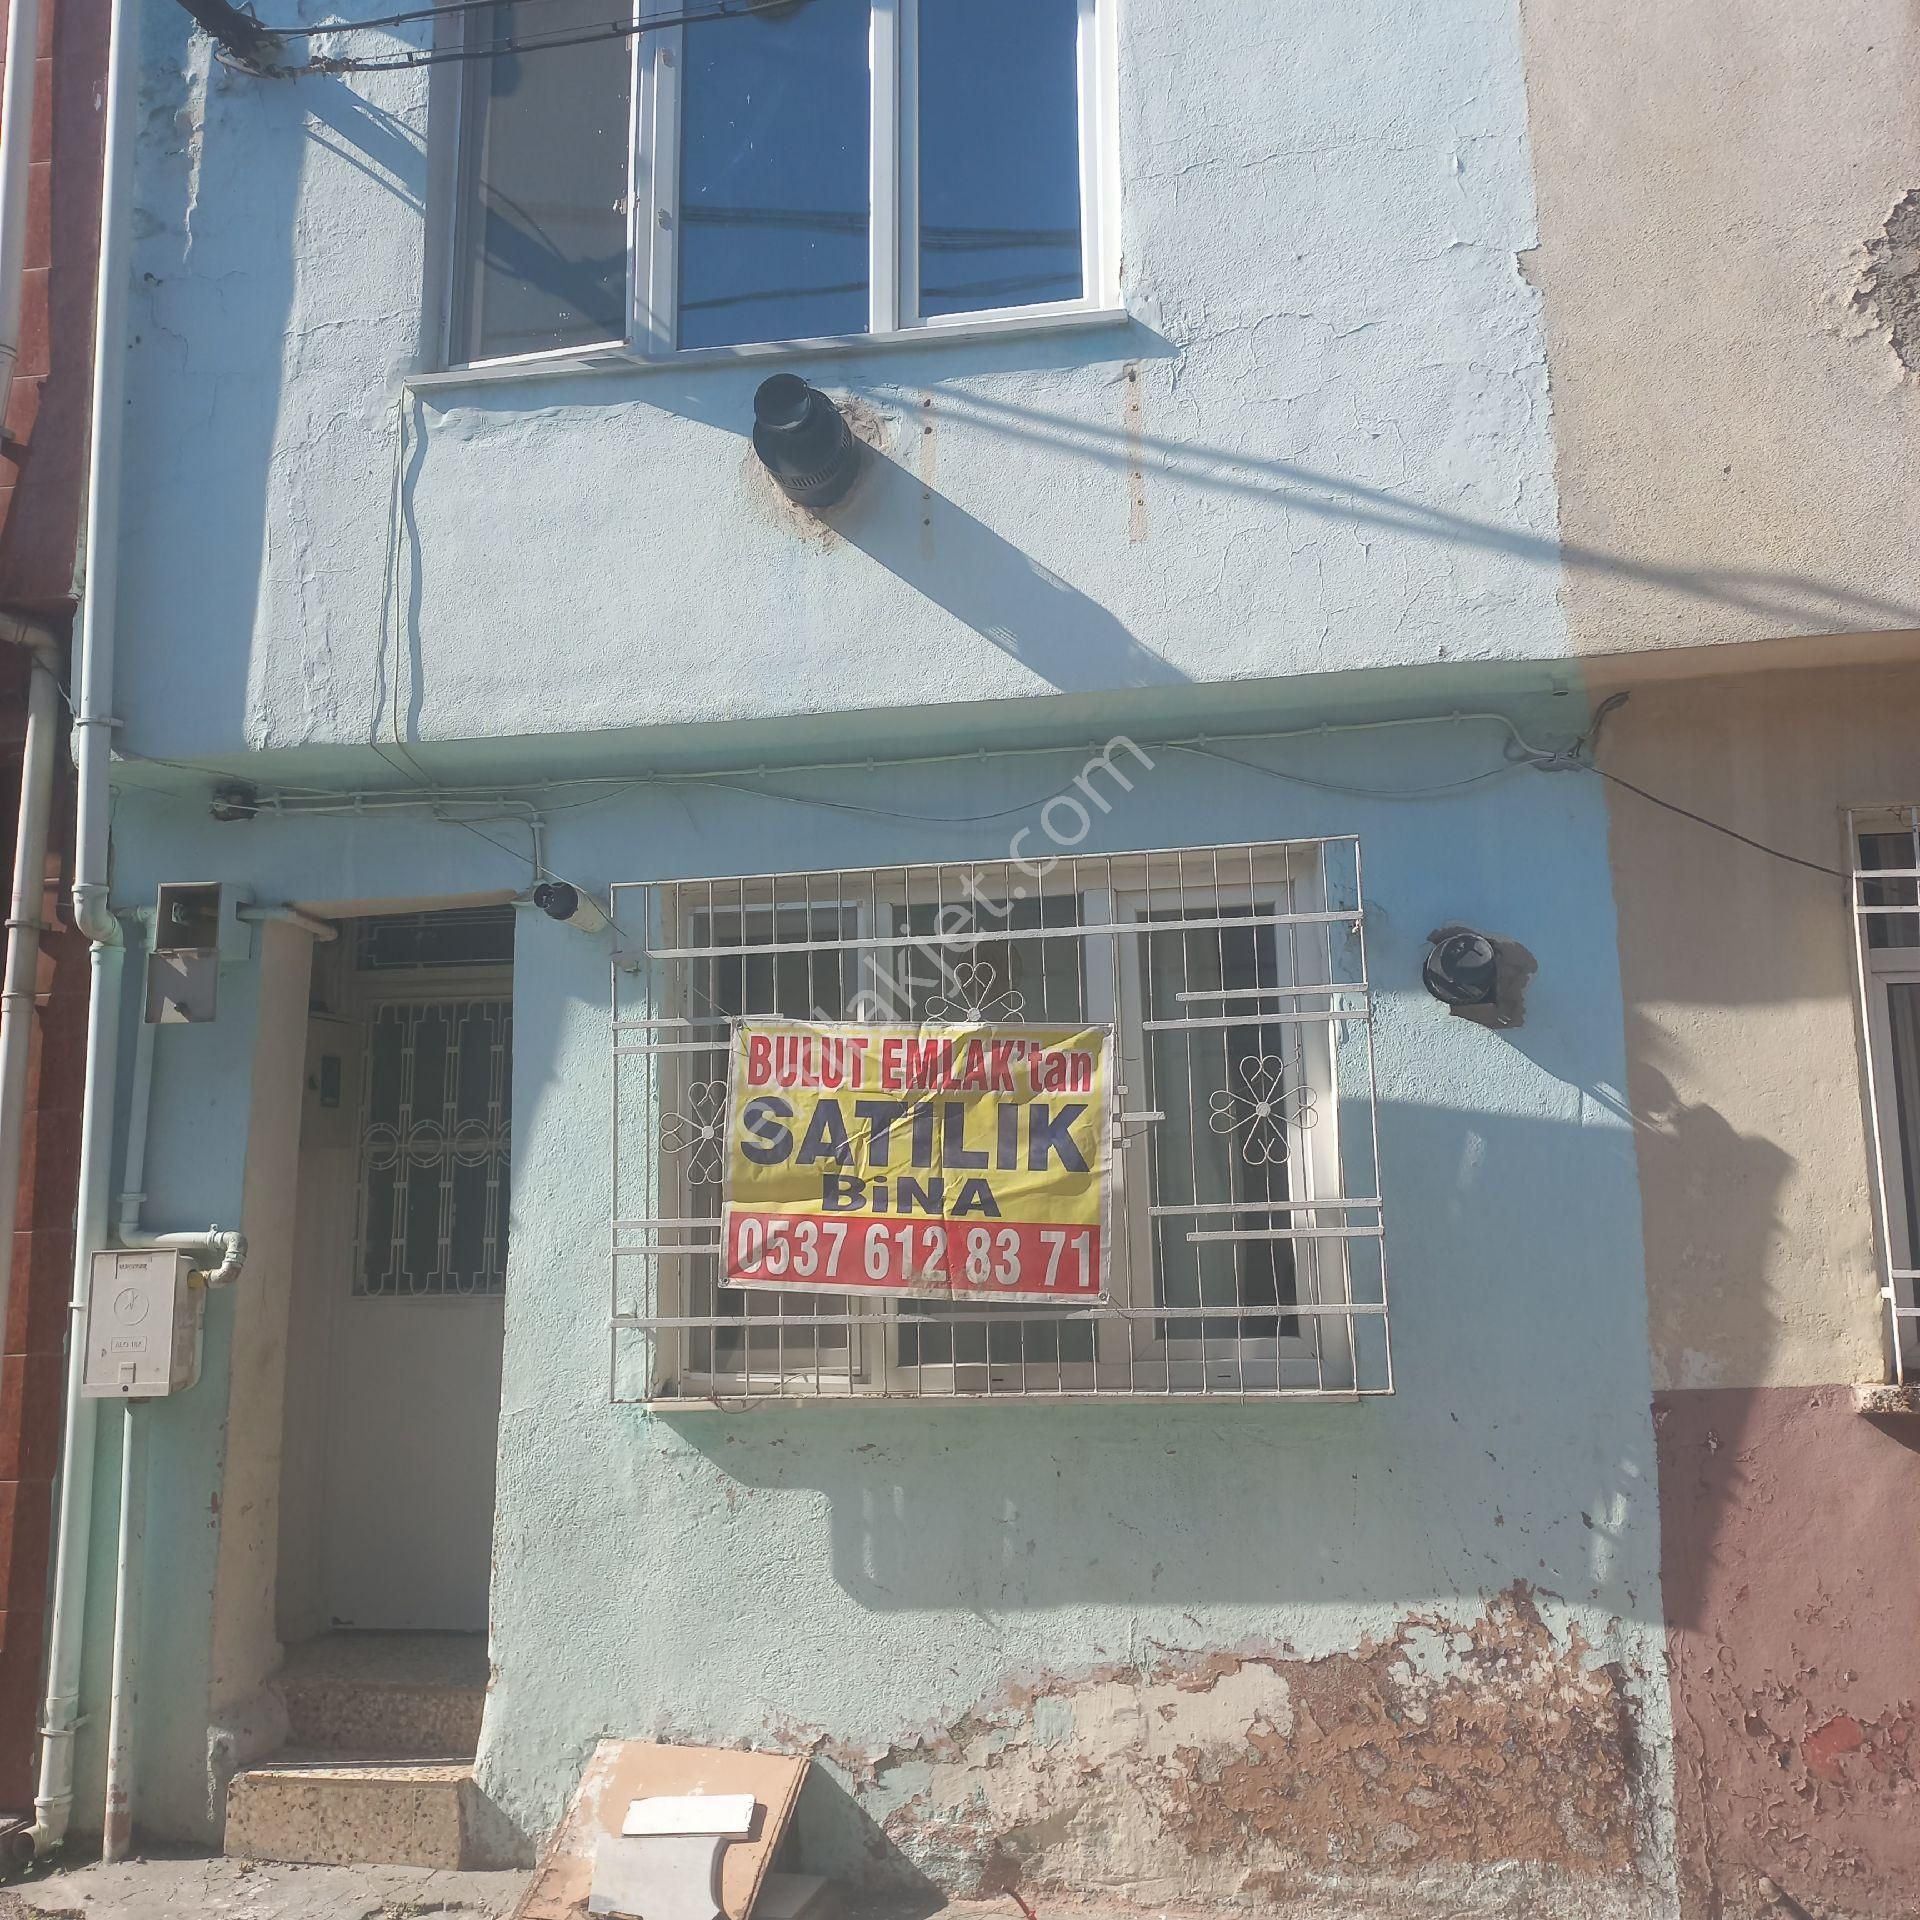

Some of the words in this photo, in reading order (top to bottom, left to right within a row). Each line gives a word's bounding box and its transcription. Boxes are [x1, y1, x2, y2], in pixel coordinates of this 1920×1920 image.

[747, 1035, 868, 1089] BULUT
[881, 1038, 1092, 1093] EMLAK'tan
[740, 1096, 1091, 1173] SATILIK
[821, 1174, 1002, 1217] BiNA
[737, 1218, 848, 1277] 0537
[864, 1224, 948, 1282] 612
[966, 1227, 1021, 1285] 83
[1040, 1230, 1091, 1287] 71
